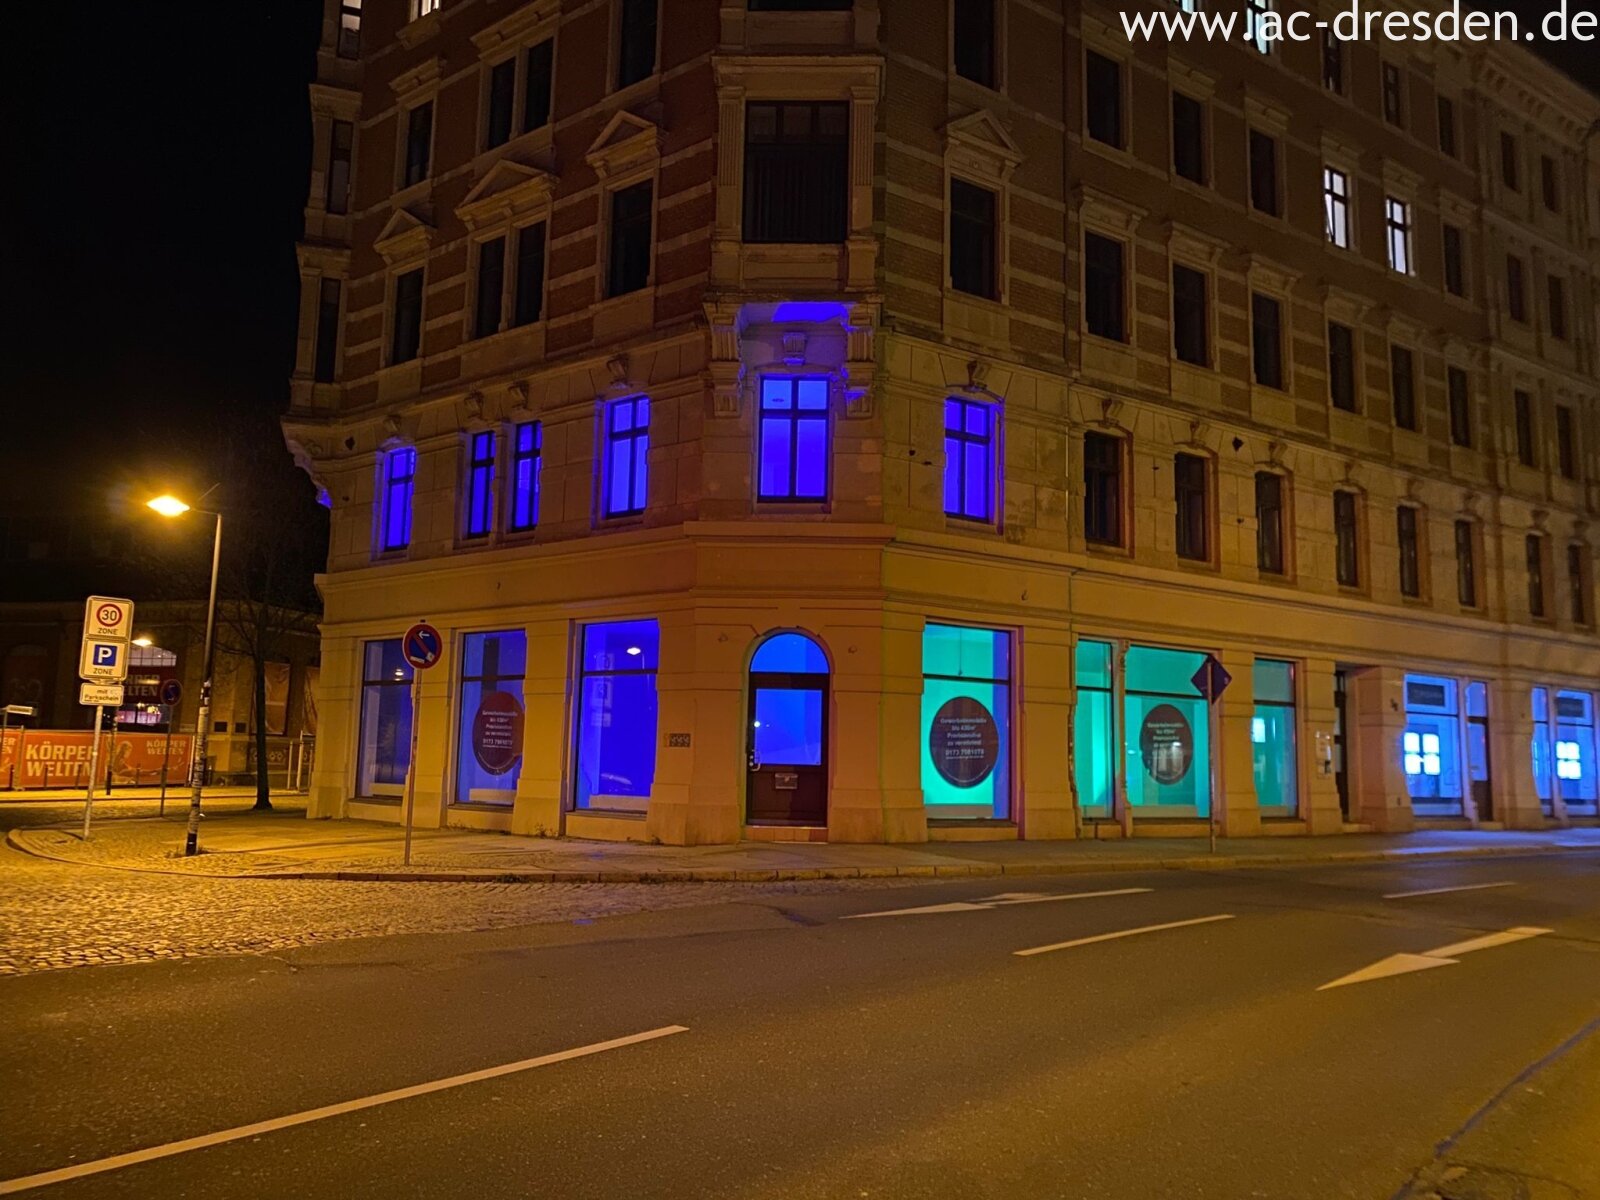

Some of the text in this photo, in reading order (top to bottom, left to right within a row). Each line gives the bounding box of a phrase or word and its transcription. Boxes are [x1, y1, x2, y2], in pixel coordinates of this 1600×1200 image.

[102, 609, 117, 621] 30
[98, 627, 118, 635] ZONE
[97, 647, 112, 664] P
[93, 667, 113, 675] ZONE
